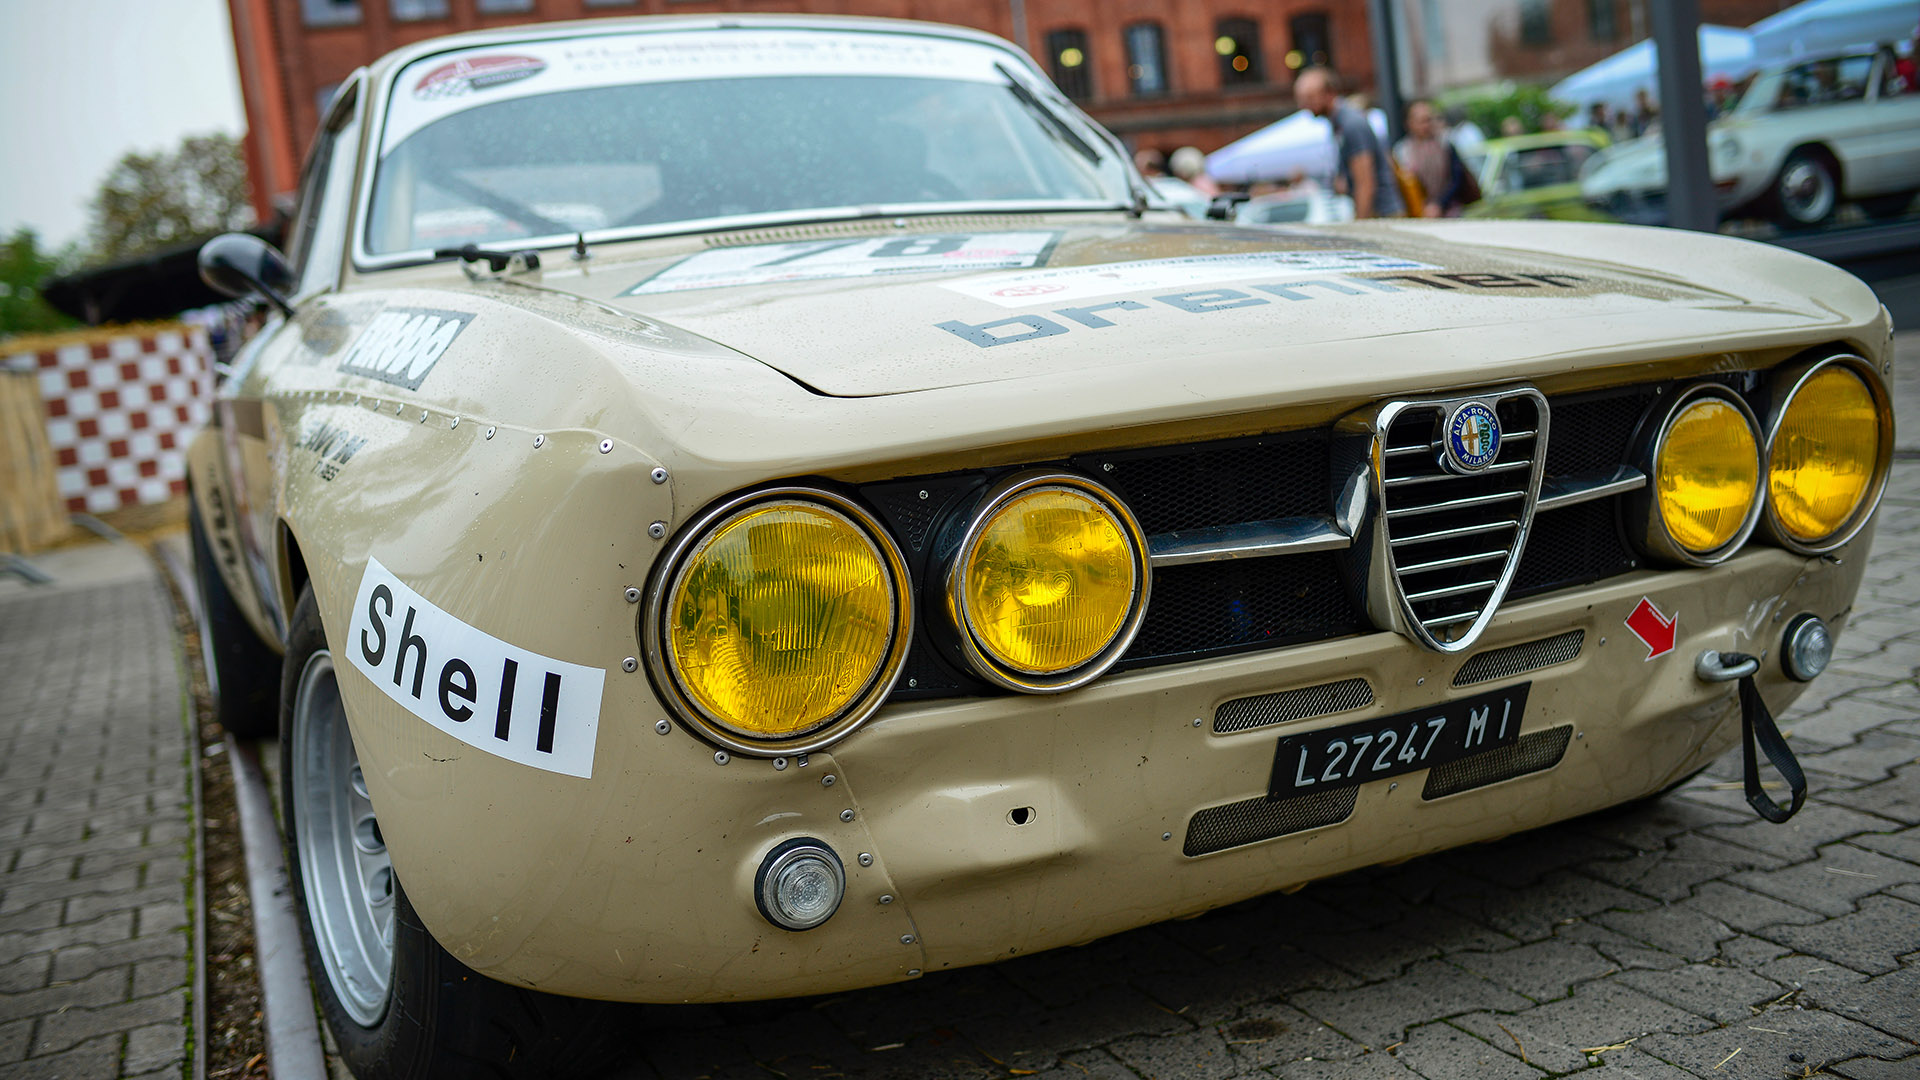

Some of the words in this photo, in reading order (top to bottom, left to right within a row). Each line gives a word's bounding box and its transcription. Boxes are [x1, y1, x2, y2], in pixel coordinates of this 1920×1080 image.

[932, 273, 1588, 348] brenner
[1461, 448, 1494, 464] MILANO
[360, 583, 562, 754] Shell
[1295, 716, 1447, 788] L27247
[1464, 698, 1511, 749] MI
